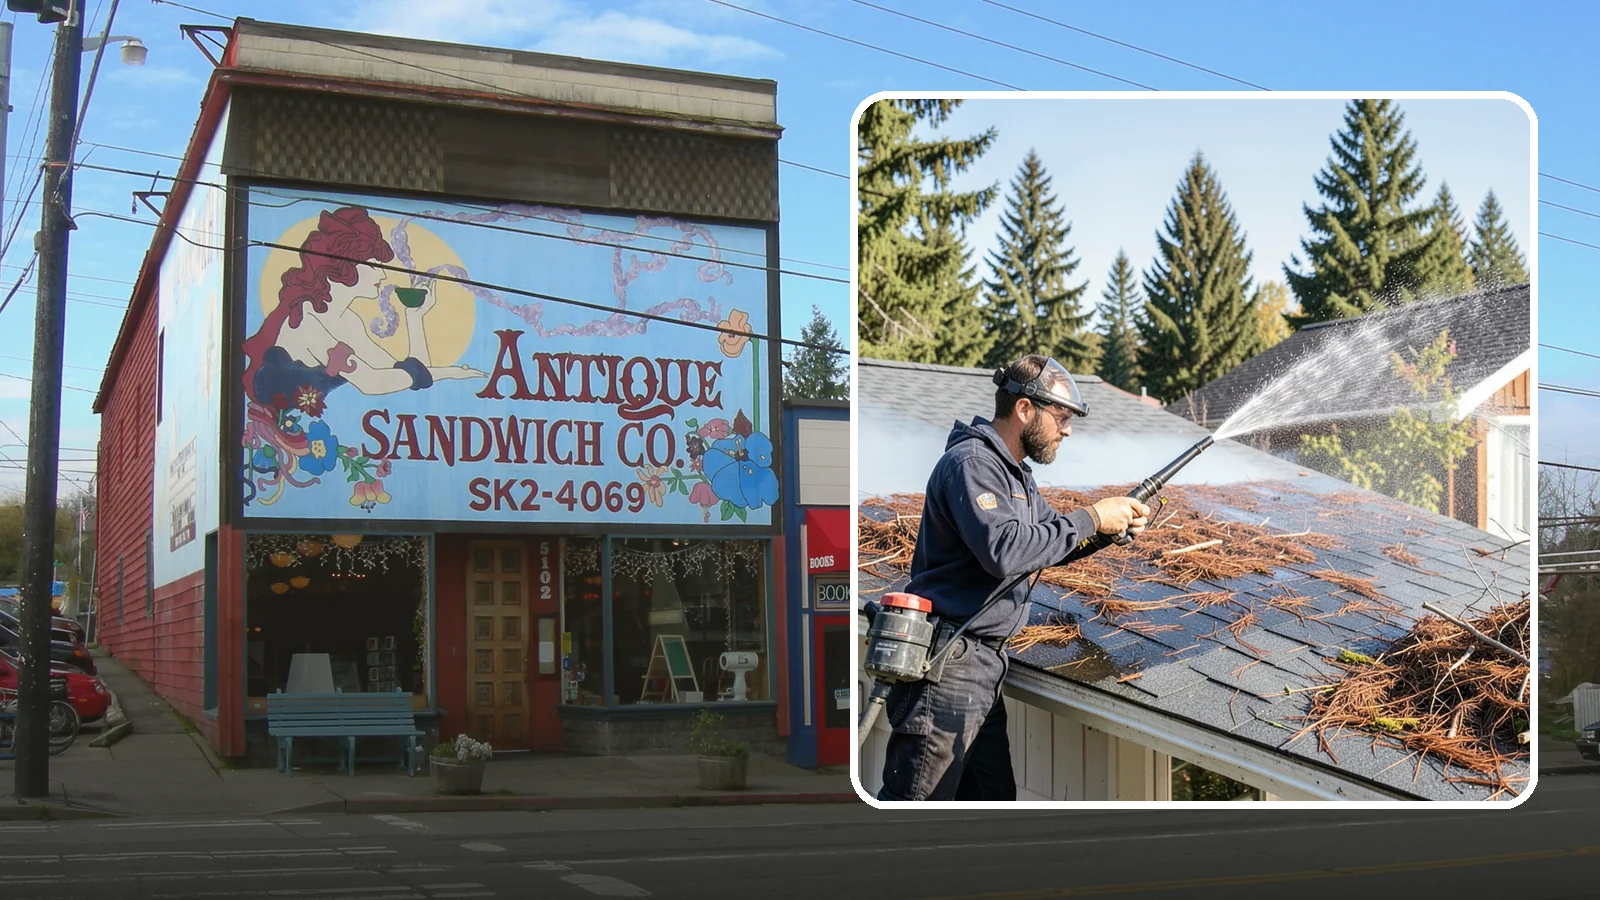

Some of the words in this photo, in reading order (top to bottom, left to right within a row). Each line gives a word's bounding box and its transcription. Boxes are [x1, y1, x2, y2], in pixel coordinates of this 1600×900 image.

[476, 329, 723, 420] ANTIQUE
[361, 408, 604, 467] SANDWICH
[617, 422, 684, 468] CO.
[468, 477, 646, 513] SK2-4069
[540, 542, 551, 600] 5102
[809, 555, 835, 569] BOOKS
